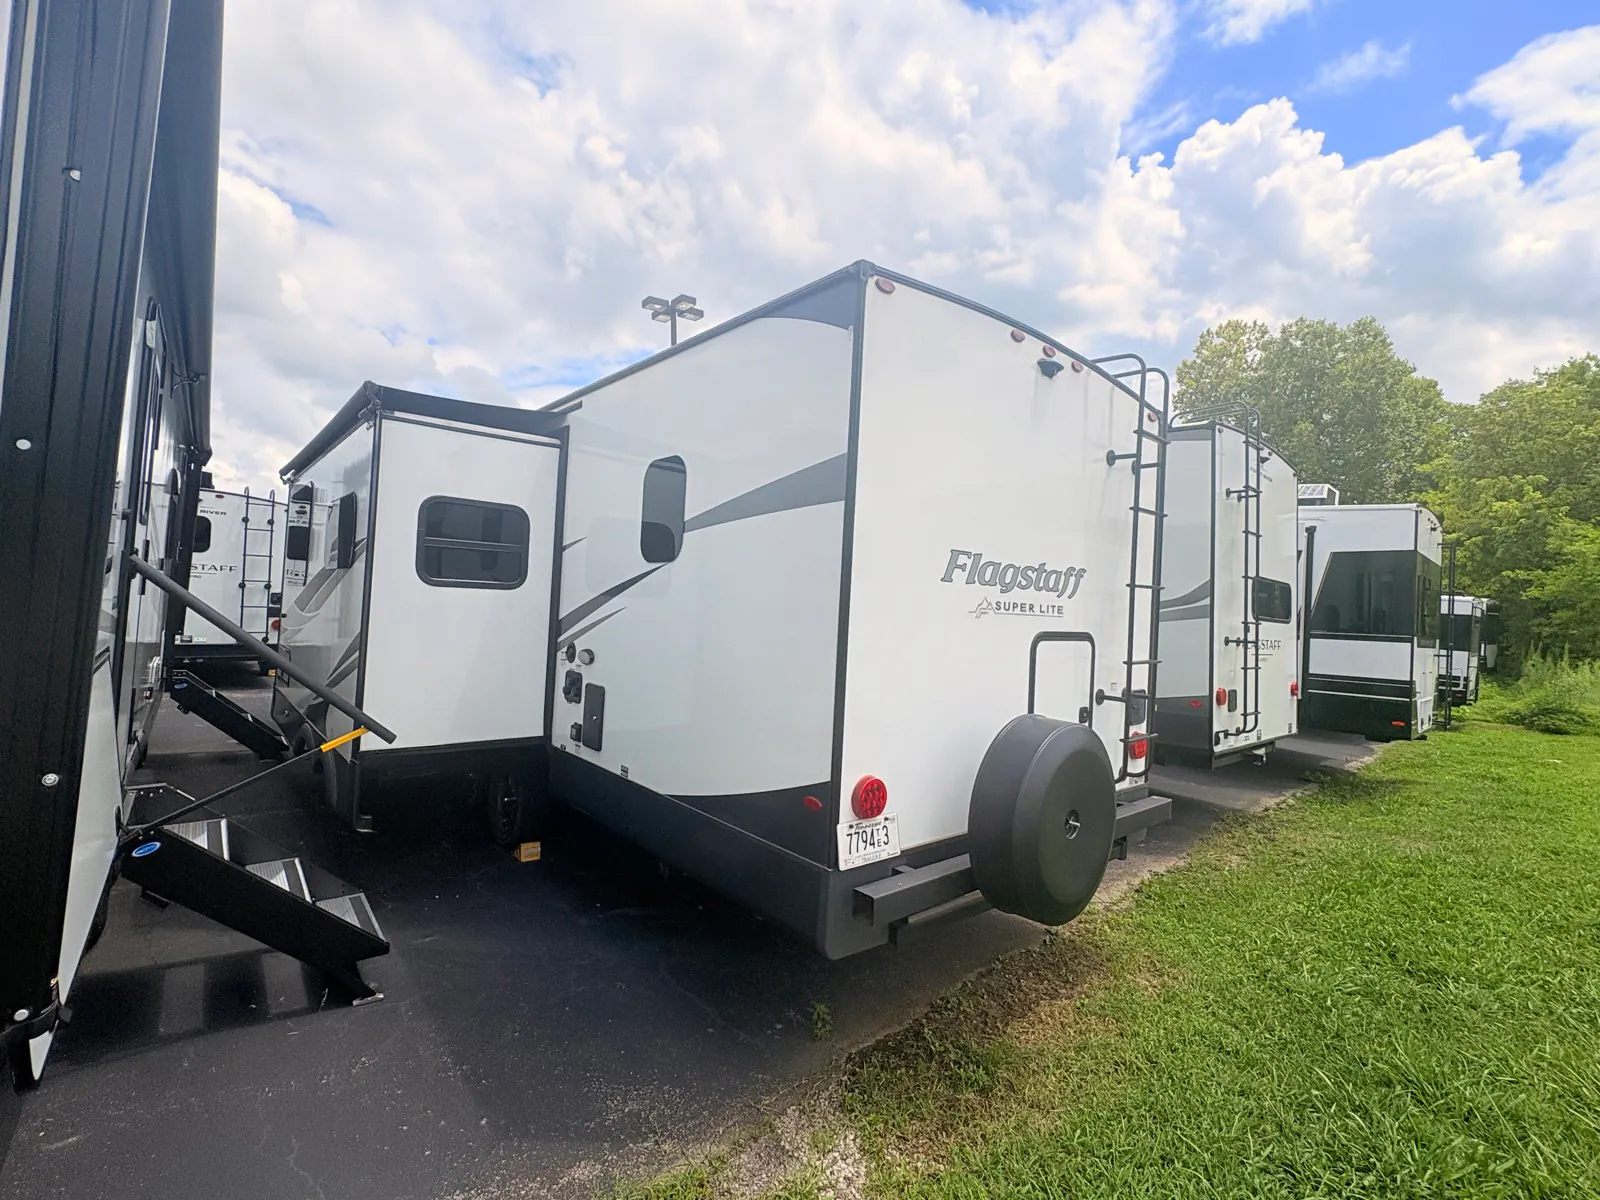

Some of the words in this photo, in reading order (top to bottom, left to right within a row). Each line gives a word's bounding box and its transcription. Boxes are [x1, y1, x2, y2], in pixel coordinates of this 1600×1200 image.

[940, 549, 1087, 599] Flagstaff
[994, 601, 1036, 613] SUPER
[1039, 604, 1064, 615] LITE
